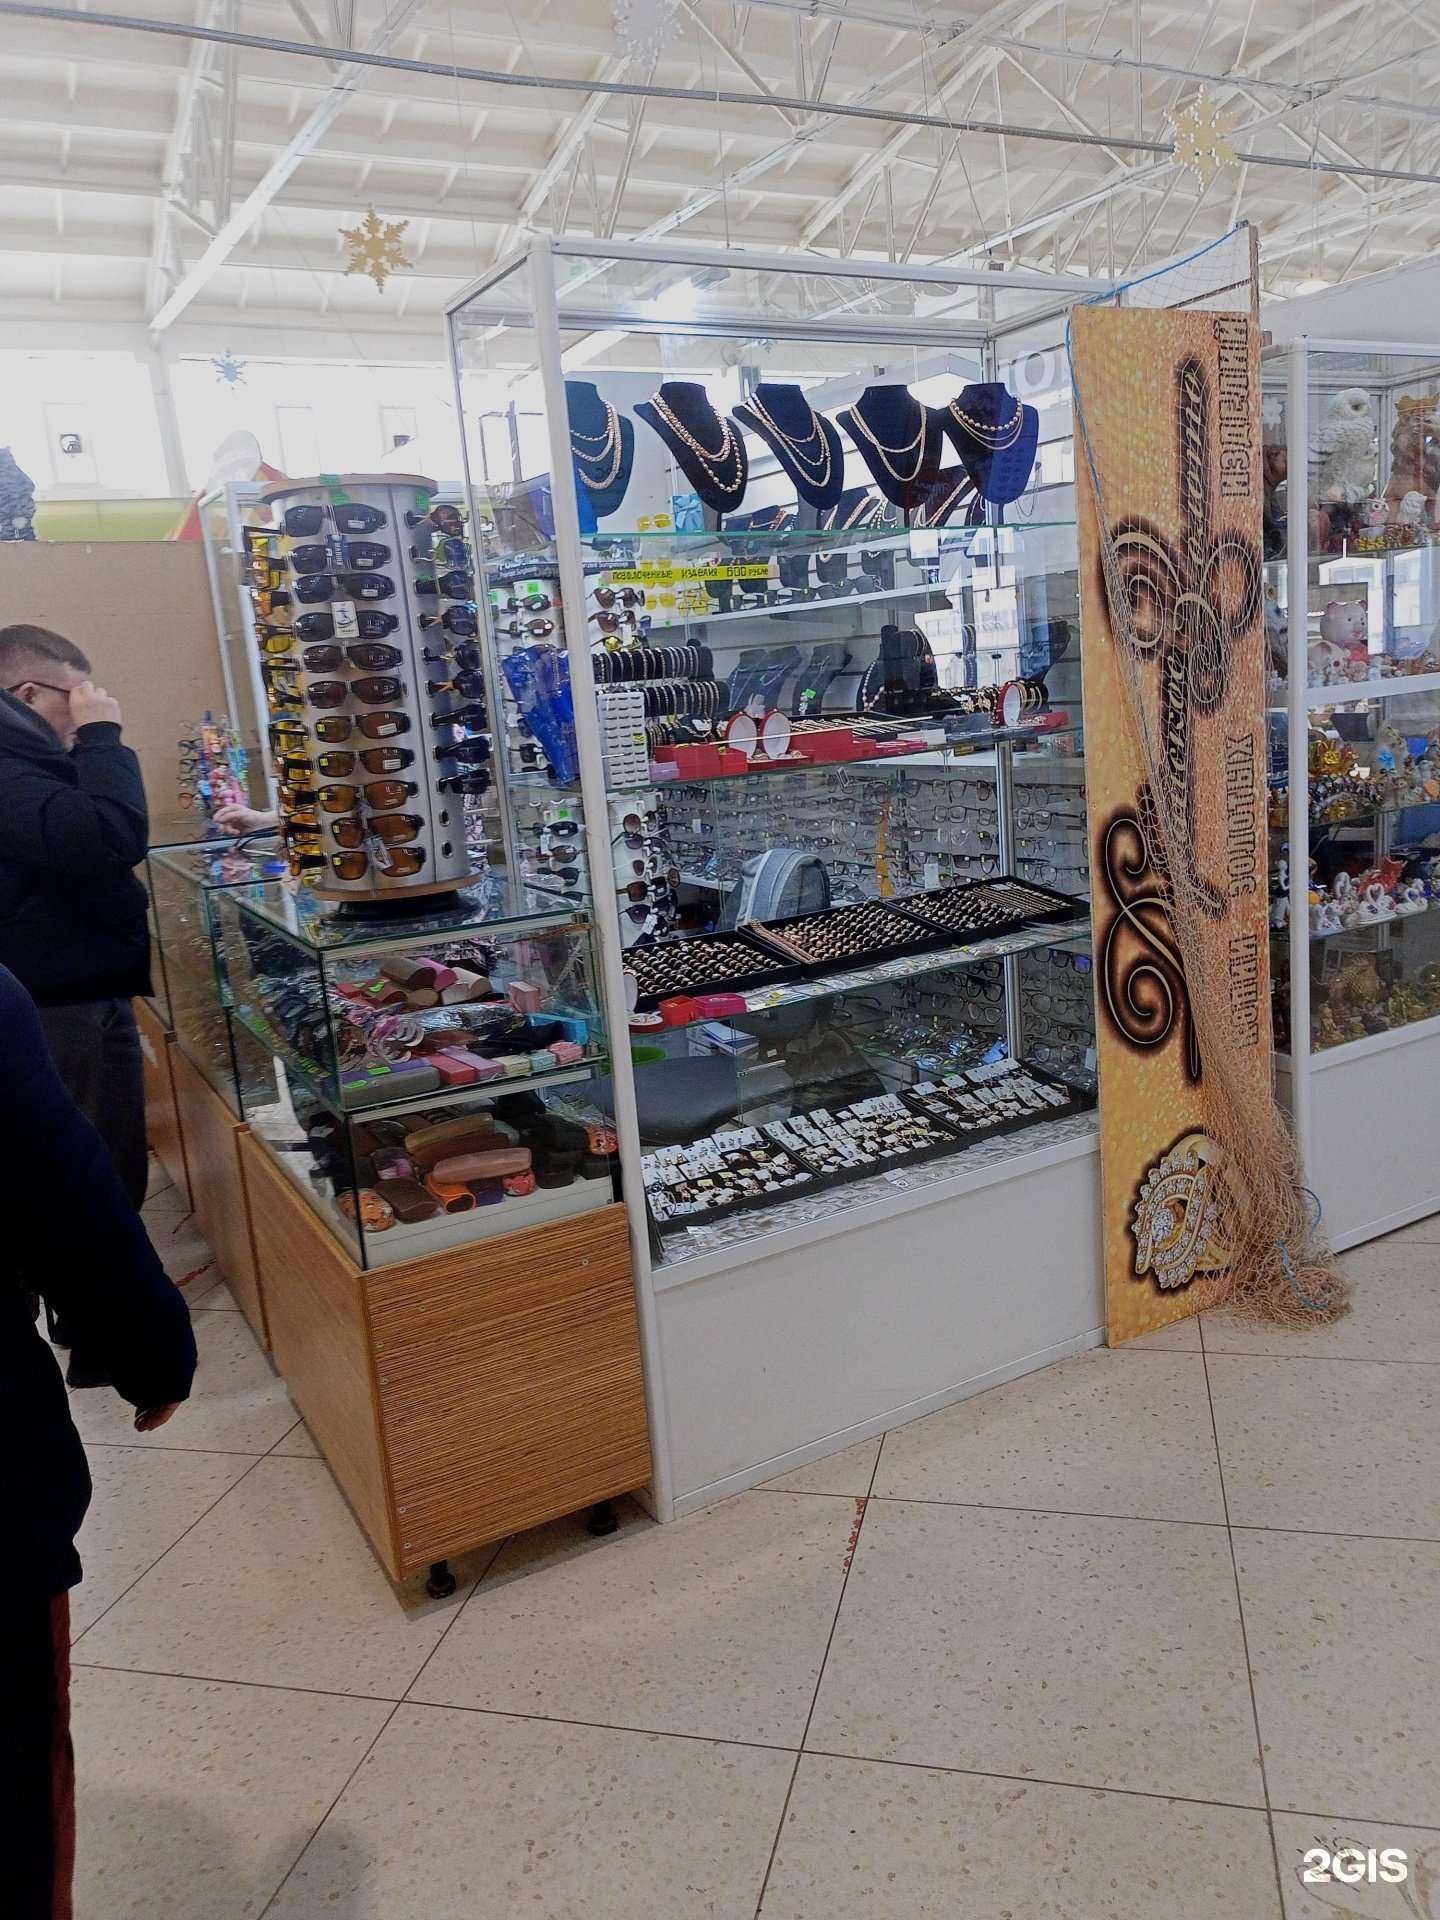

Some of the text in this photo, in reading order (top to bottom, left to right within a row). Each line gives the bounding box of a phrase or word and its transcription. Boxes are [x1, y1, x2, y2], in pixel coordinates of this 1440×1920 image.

[1213, 316, 1260, 1049] КОПИИ ЗОЛОТЫХ ИЗДЕЛИЙ
